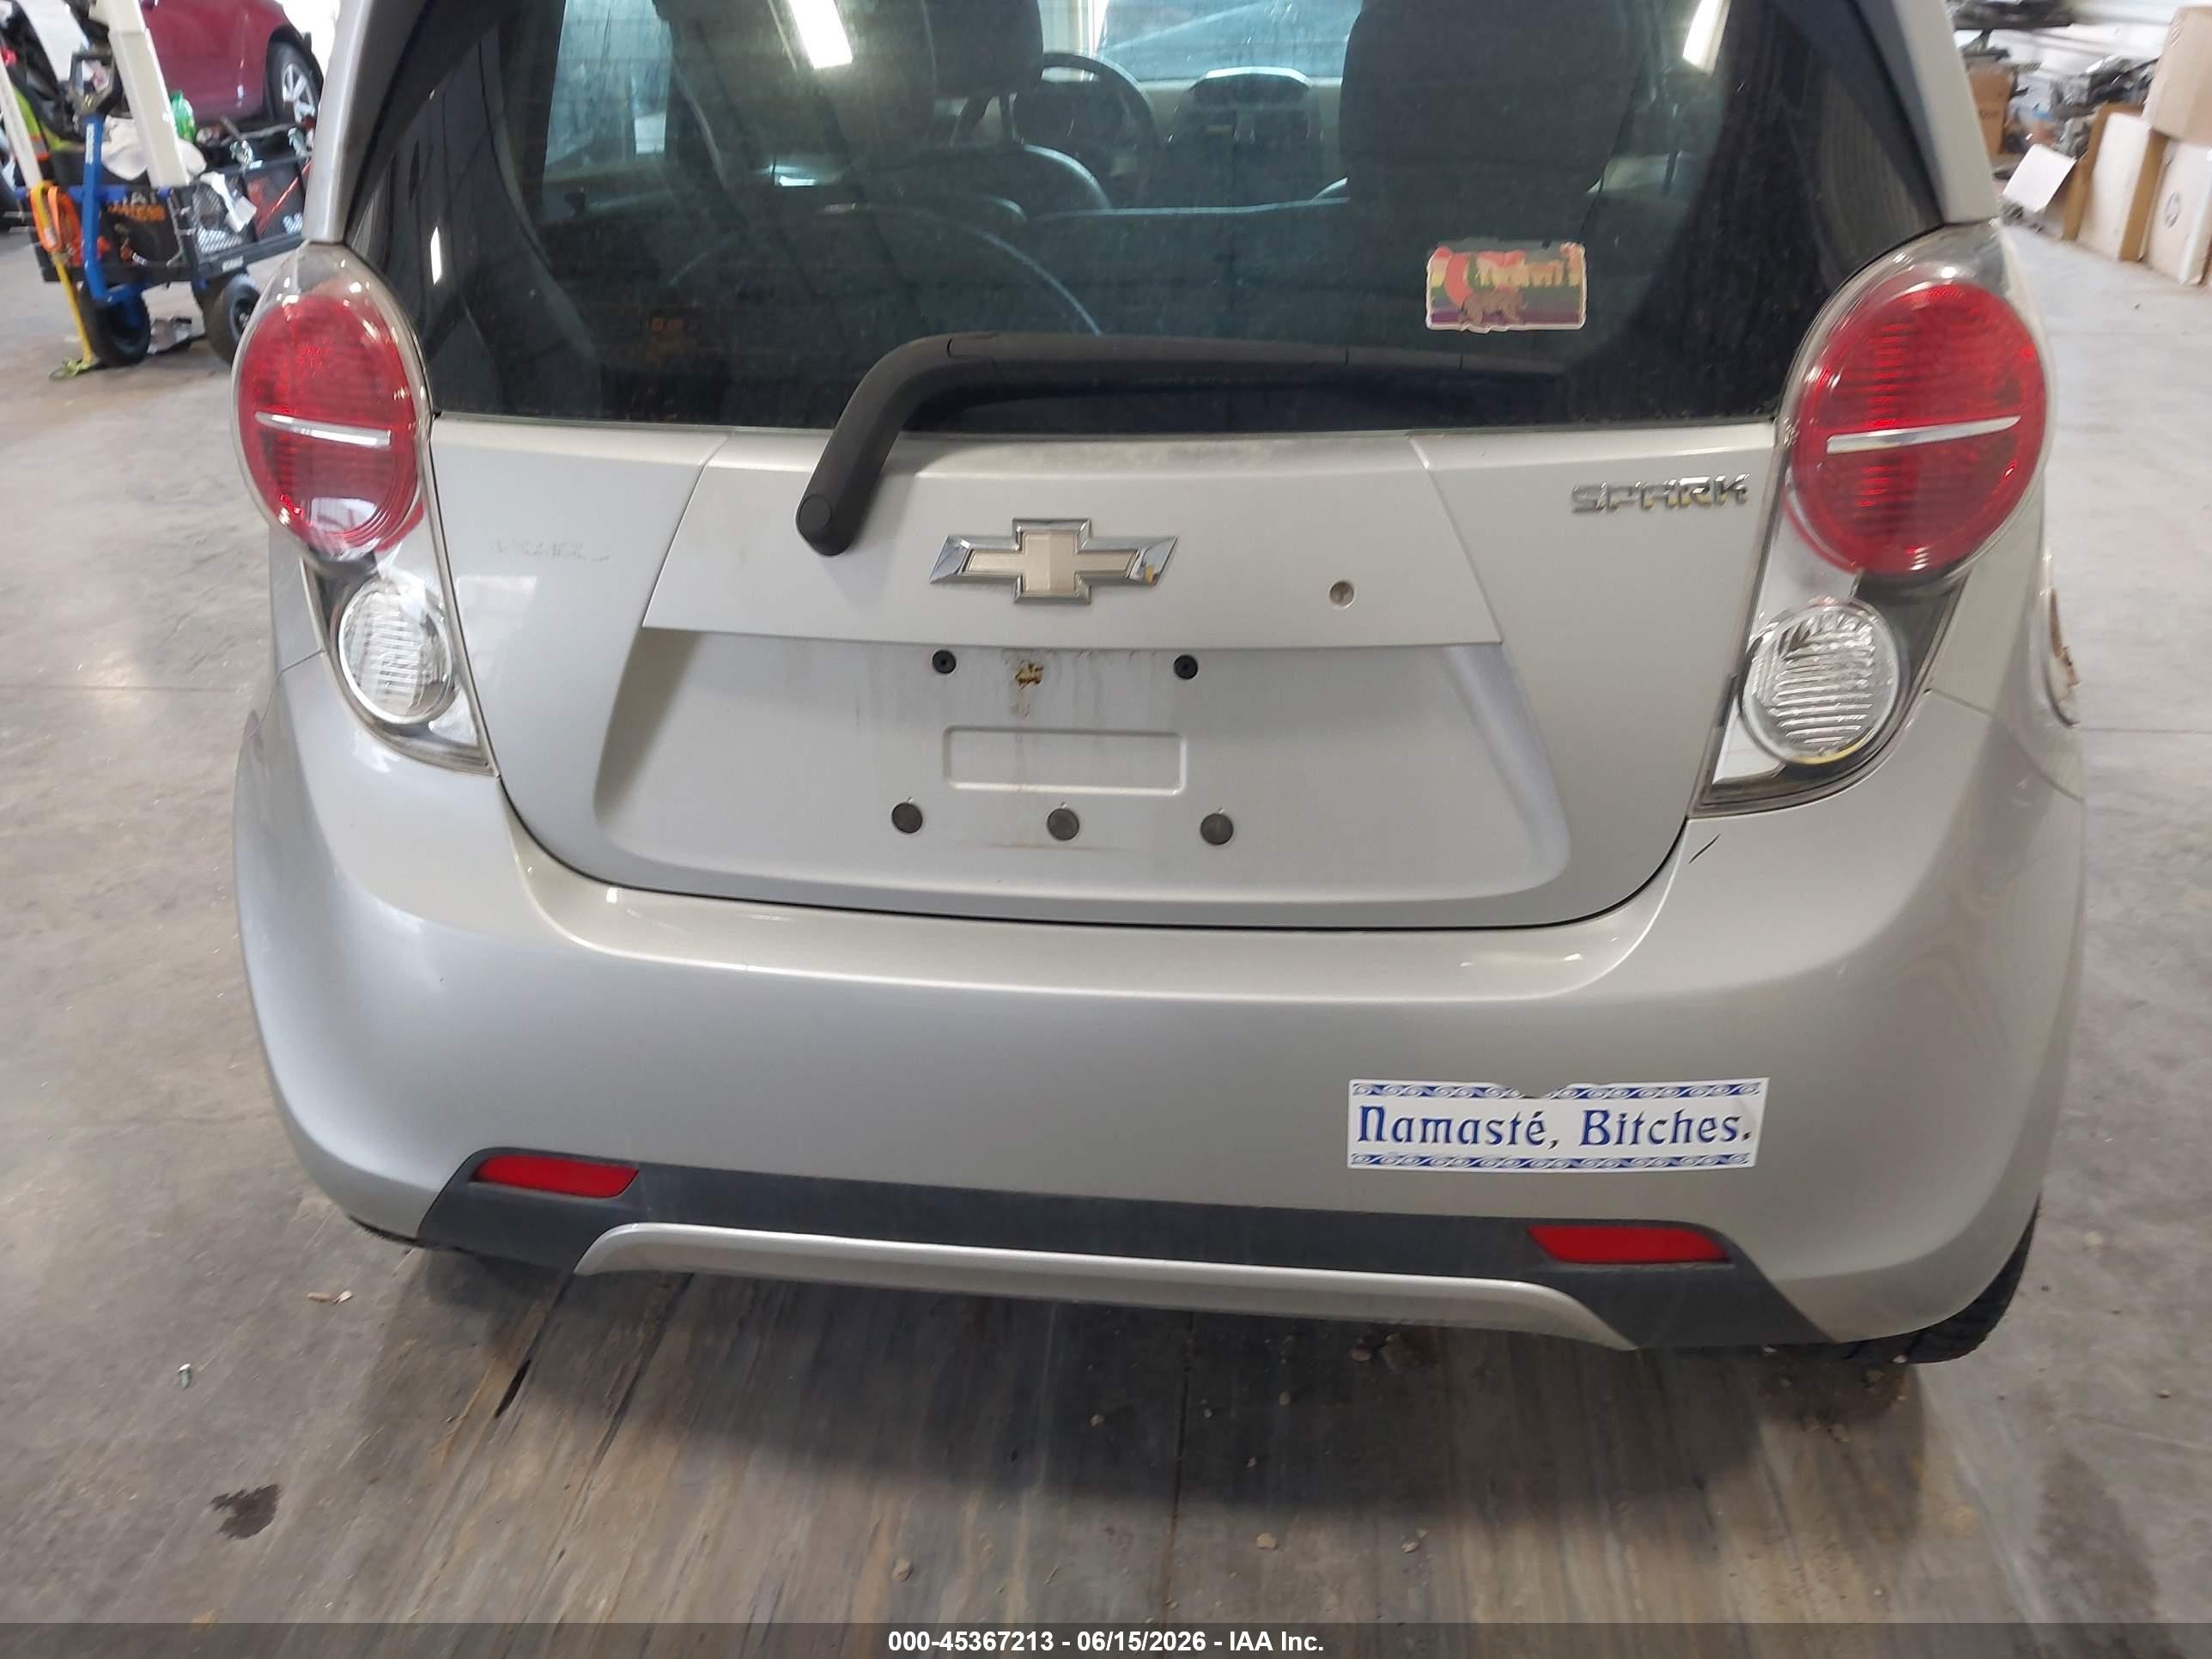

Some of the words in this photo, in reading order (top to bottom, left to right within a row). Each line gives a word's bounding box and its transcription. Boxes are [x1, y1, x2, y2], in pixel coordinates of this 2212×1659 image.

[1571, 474, 1750, 514] SPARK
[1358, 1105, 1559, 1150] Namasté,
[1578, 1109, 1753, 1146] Bitches.
